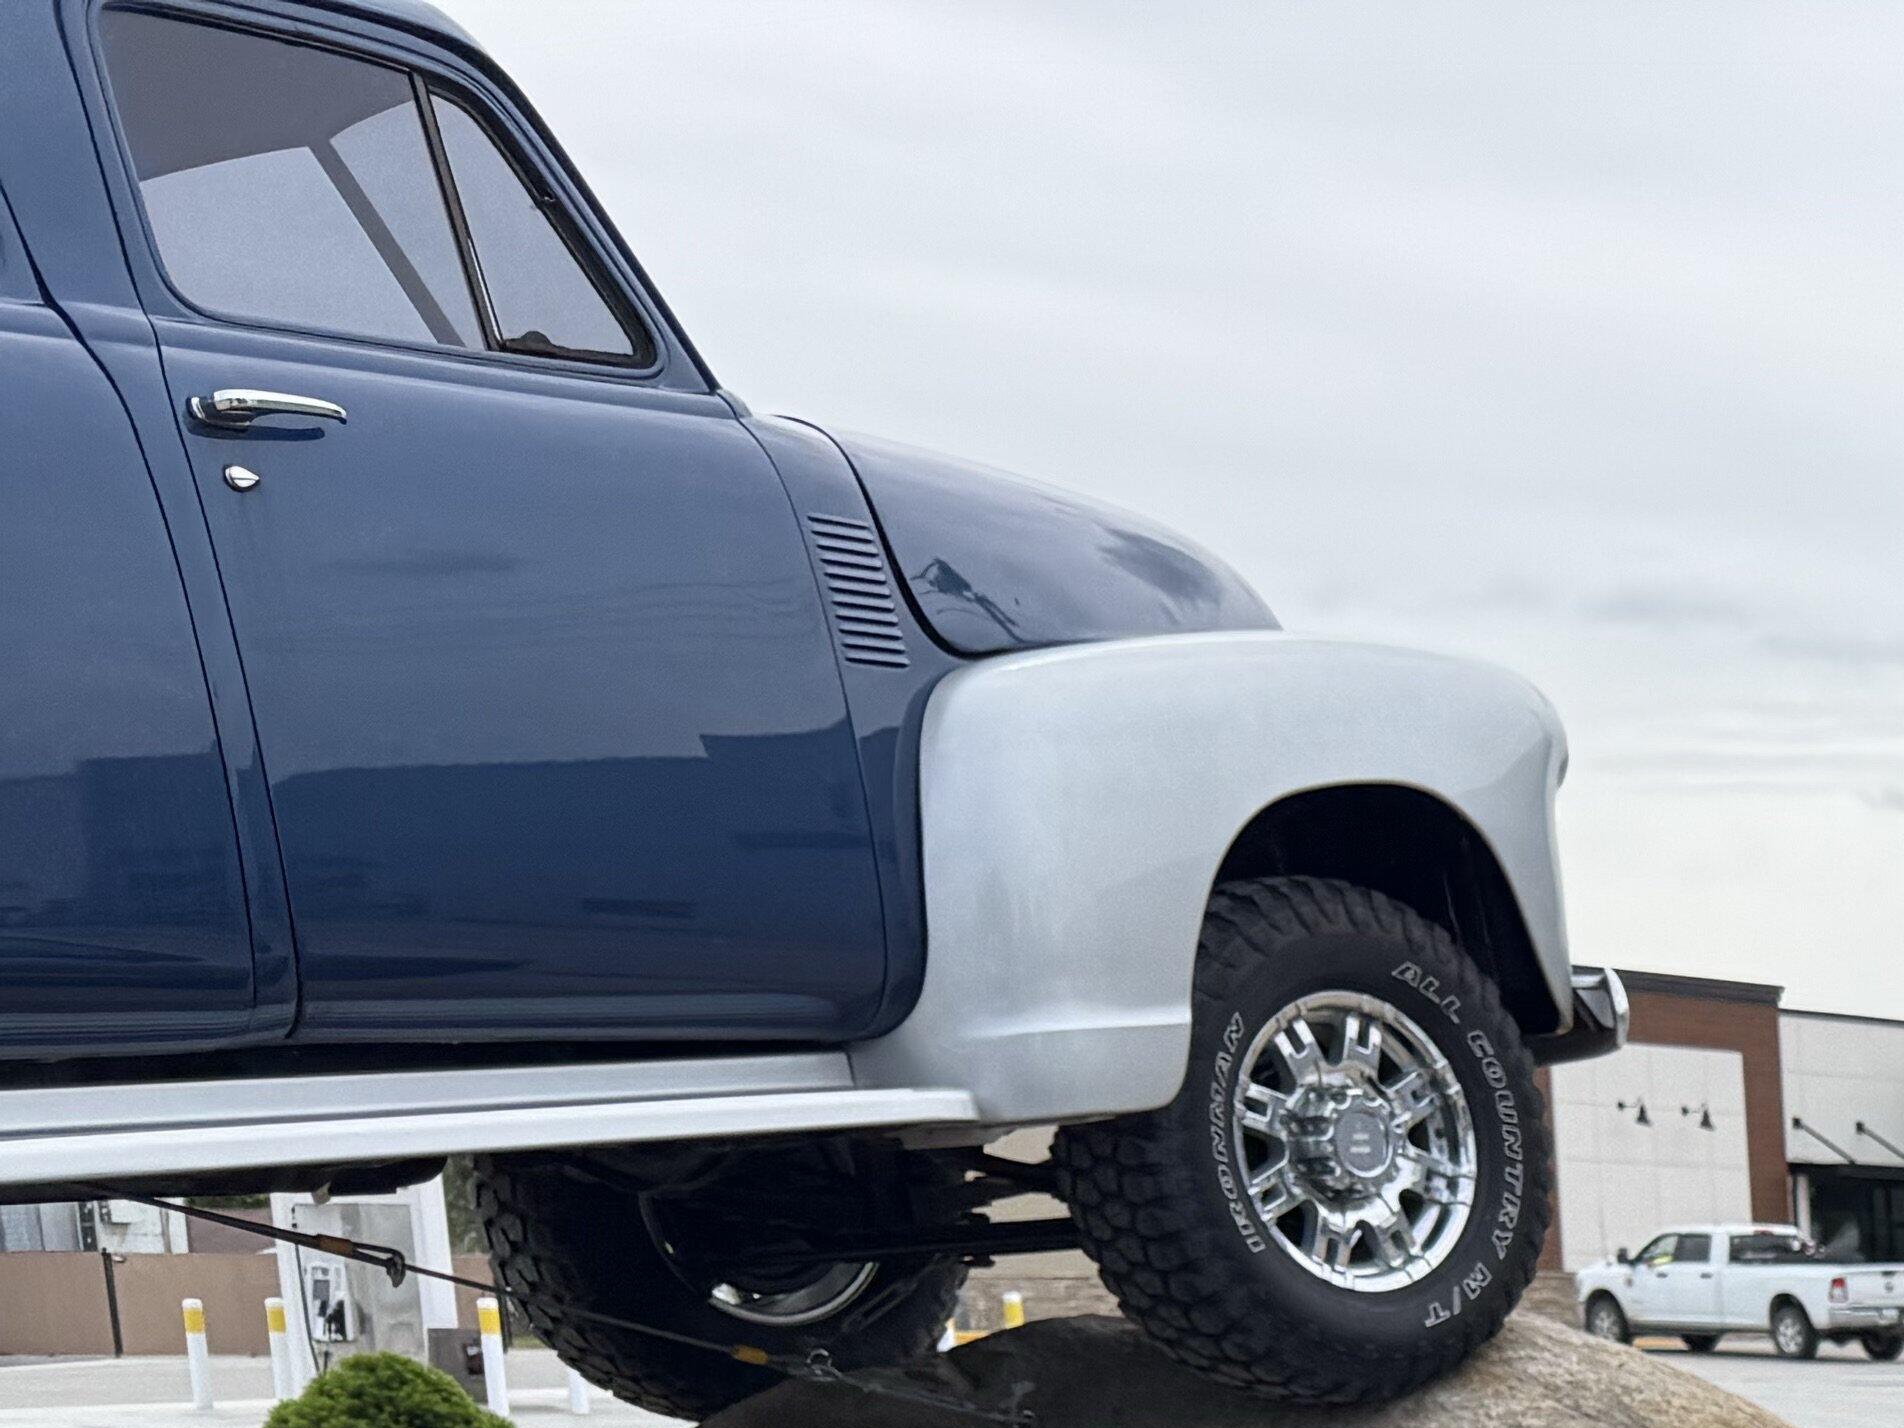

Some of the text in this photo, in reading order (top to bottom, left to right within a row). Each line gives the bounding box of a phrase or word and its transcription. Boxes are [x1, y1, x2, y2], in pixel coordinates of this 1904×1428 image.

[1208, 1011, 1267, 1254] IRONMAN
[1391, 961, 1462, 1024] ALL
[1467, 1029, 1525, 1260] COUNTRY
